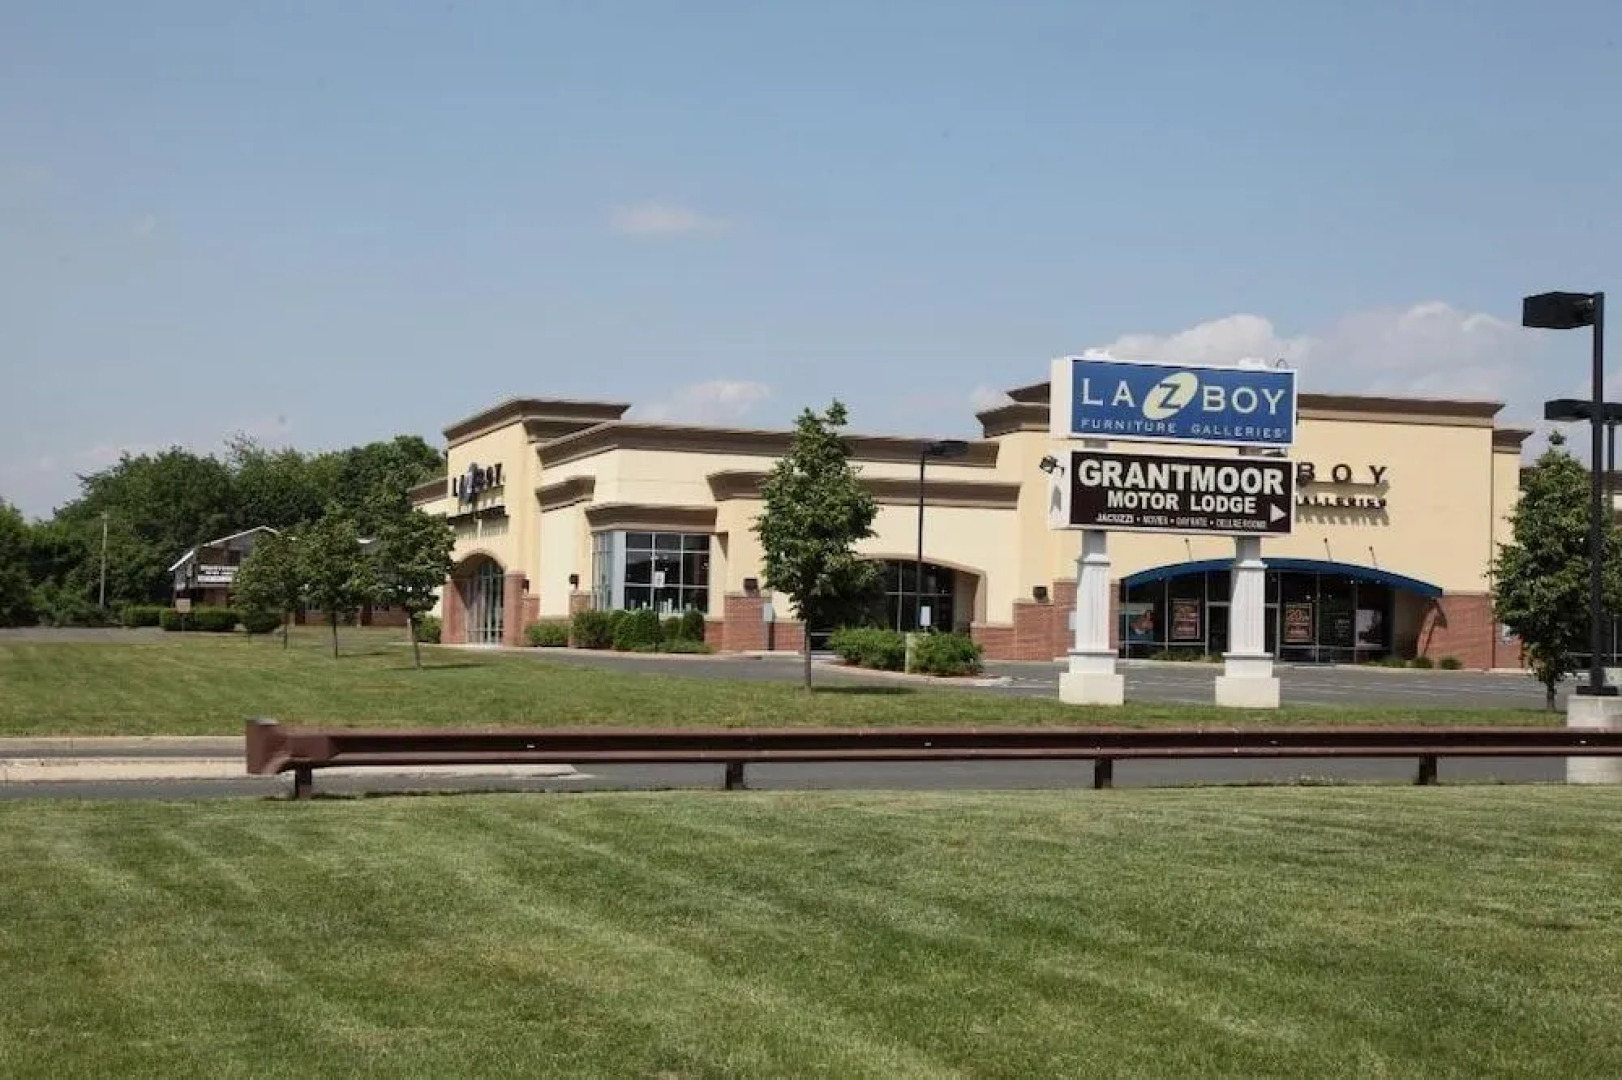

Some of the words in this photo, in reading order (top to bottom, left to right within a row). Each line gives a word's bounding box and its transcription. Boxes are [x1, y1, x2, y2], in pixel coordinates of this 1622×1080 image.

[1202, 385, 1286, 416] BOY
[1080, 419, 1178, 434] FURNITURE
[1191, 423, 1283, 439] GALLERIES
[1078, 458, 1285, 496] GRANTMOOR
[1296, 462, 1388, 485] BOY
[1107, 490, 1180, 511] MOTOR
[1190, 495, 1258, 515] LODGE
